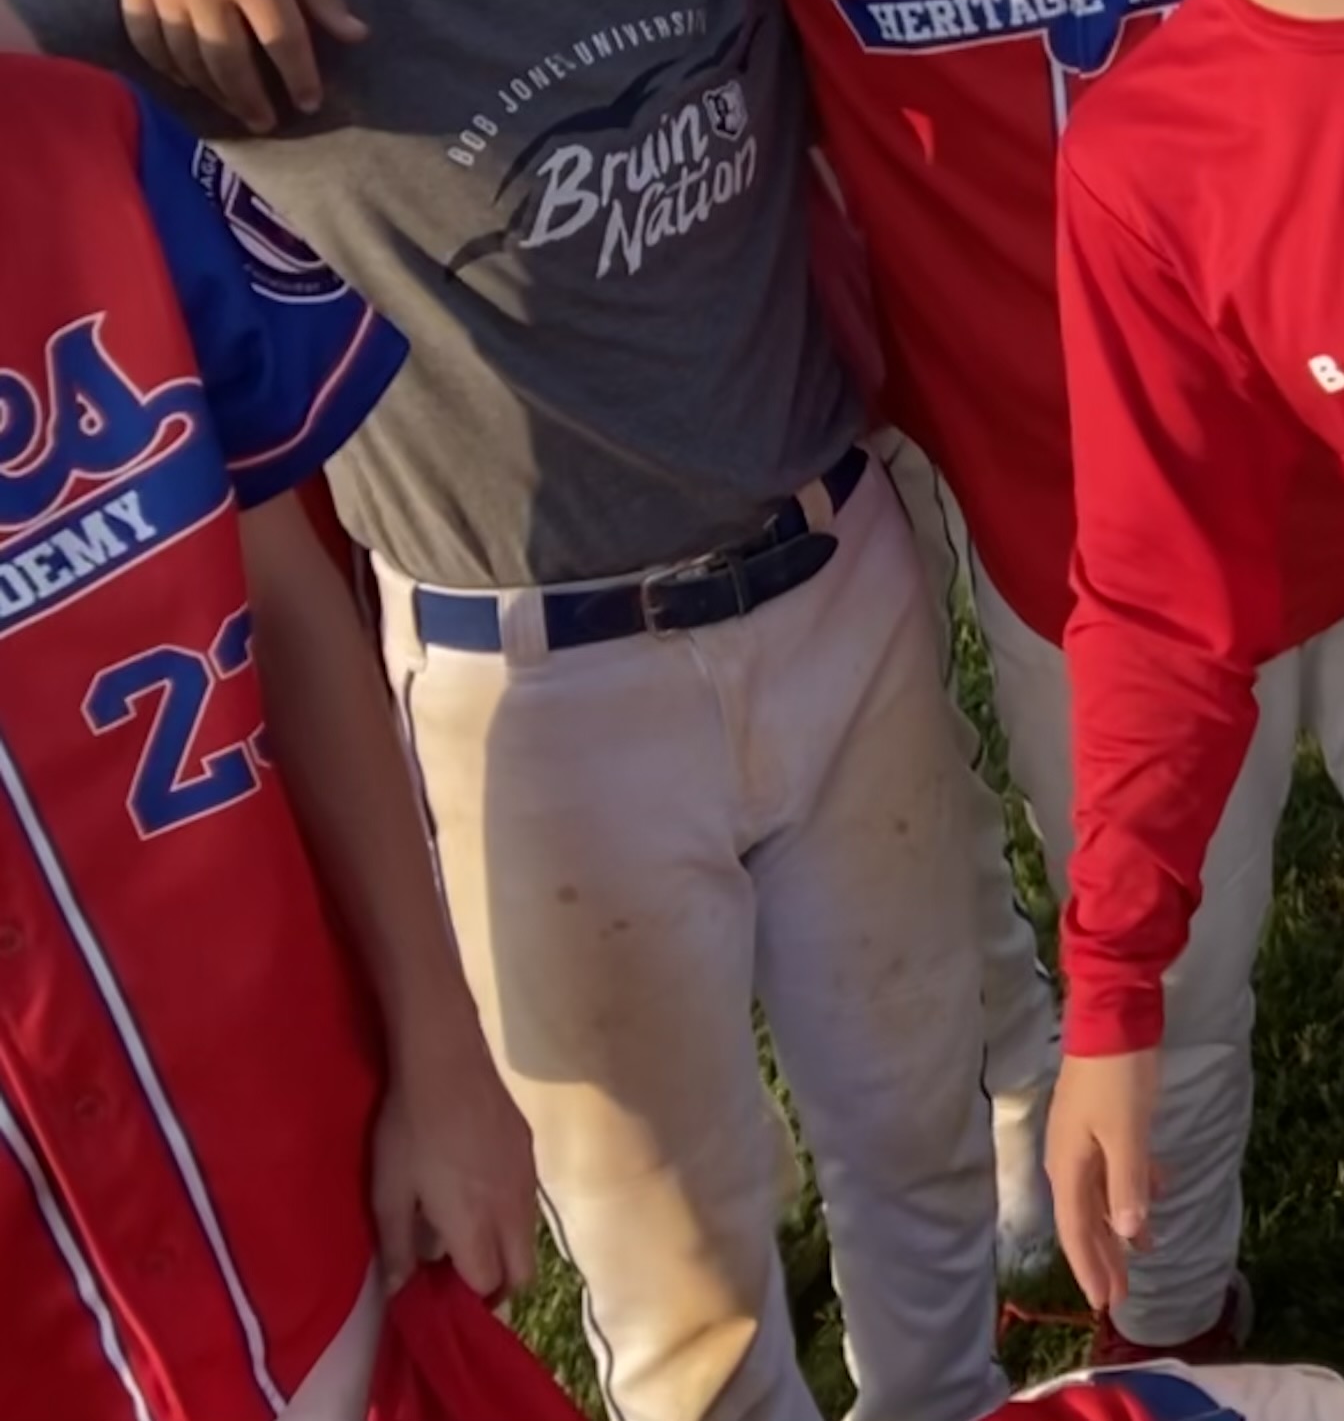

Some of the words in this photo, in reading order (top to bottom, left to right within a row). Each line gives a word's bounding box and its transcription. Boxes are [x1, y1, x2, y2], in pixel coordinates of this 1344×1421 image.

[447, 113, 499, 167] BOB
[573, 8, 707, 67] UNIVERSI
[519, 104, 709, 249] Bruin
[595, 134, 757, 280] Nation
